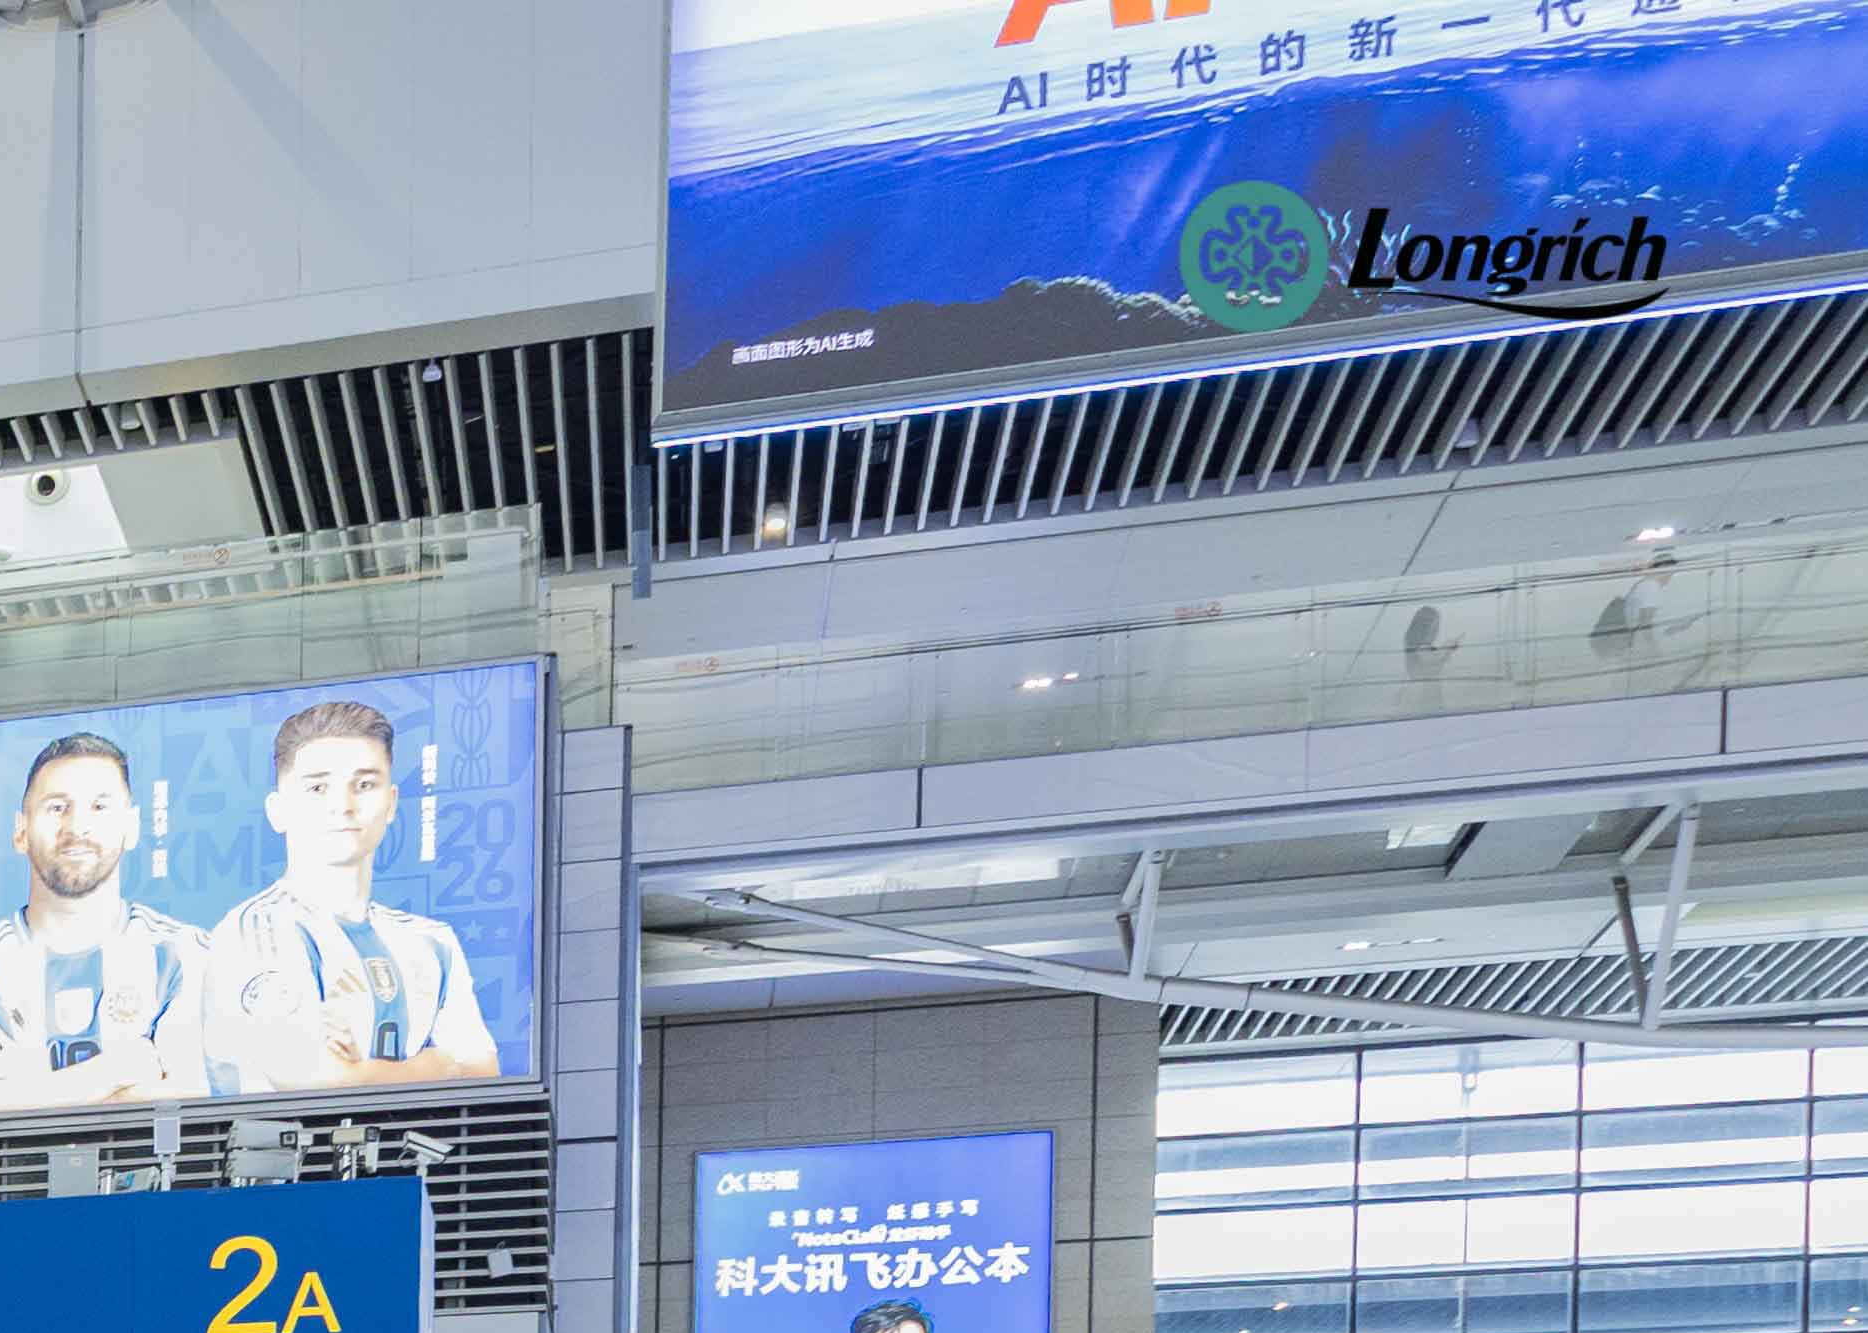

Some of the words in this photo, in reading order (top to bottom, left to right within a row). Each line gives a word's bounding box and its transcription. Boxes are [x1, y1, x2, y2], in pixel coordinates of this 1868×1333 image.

[732, 328, 874, 365] 画面图形为AI生成
[715, 1242, 1030, 1297] 科大讯飞办公本
